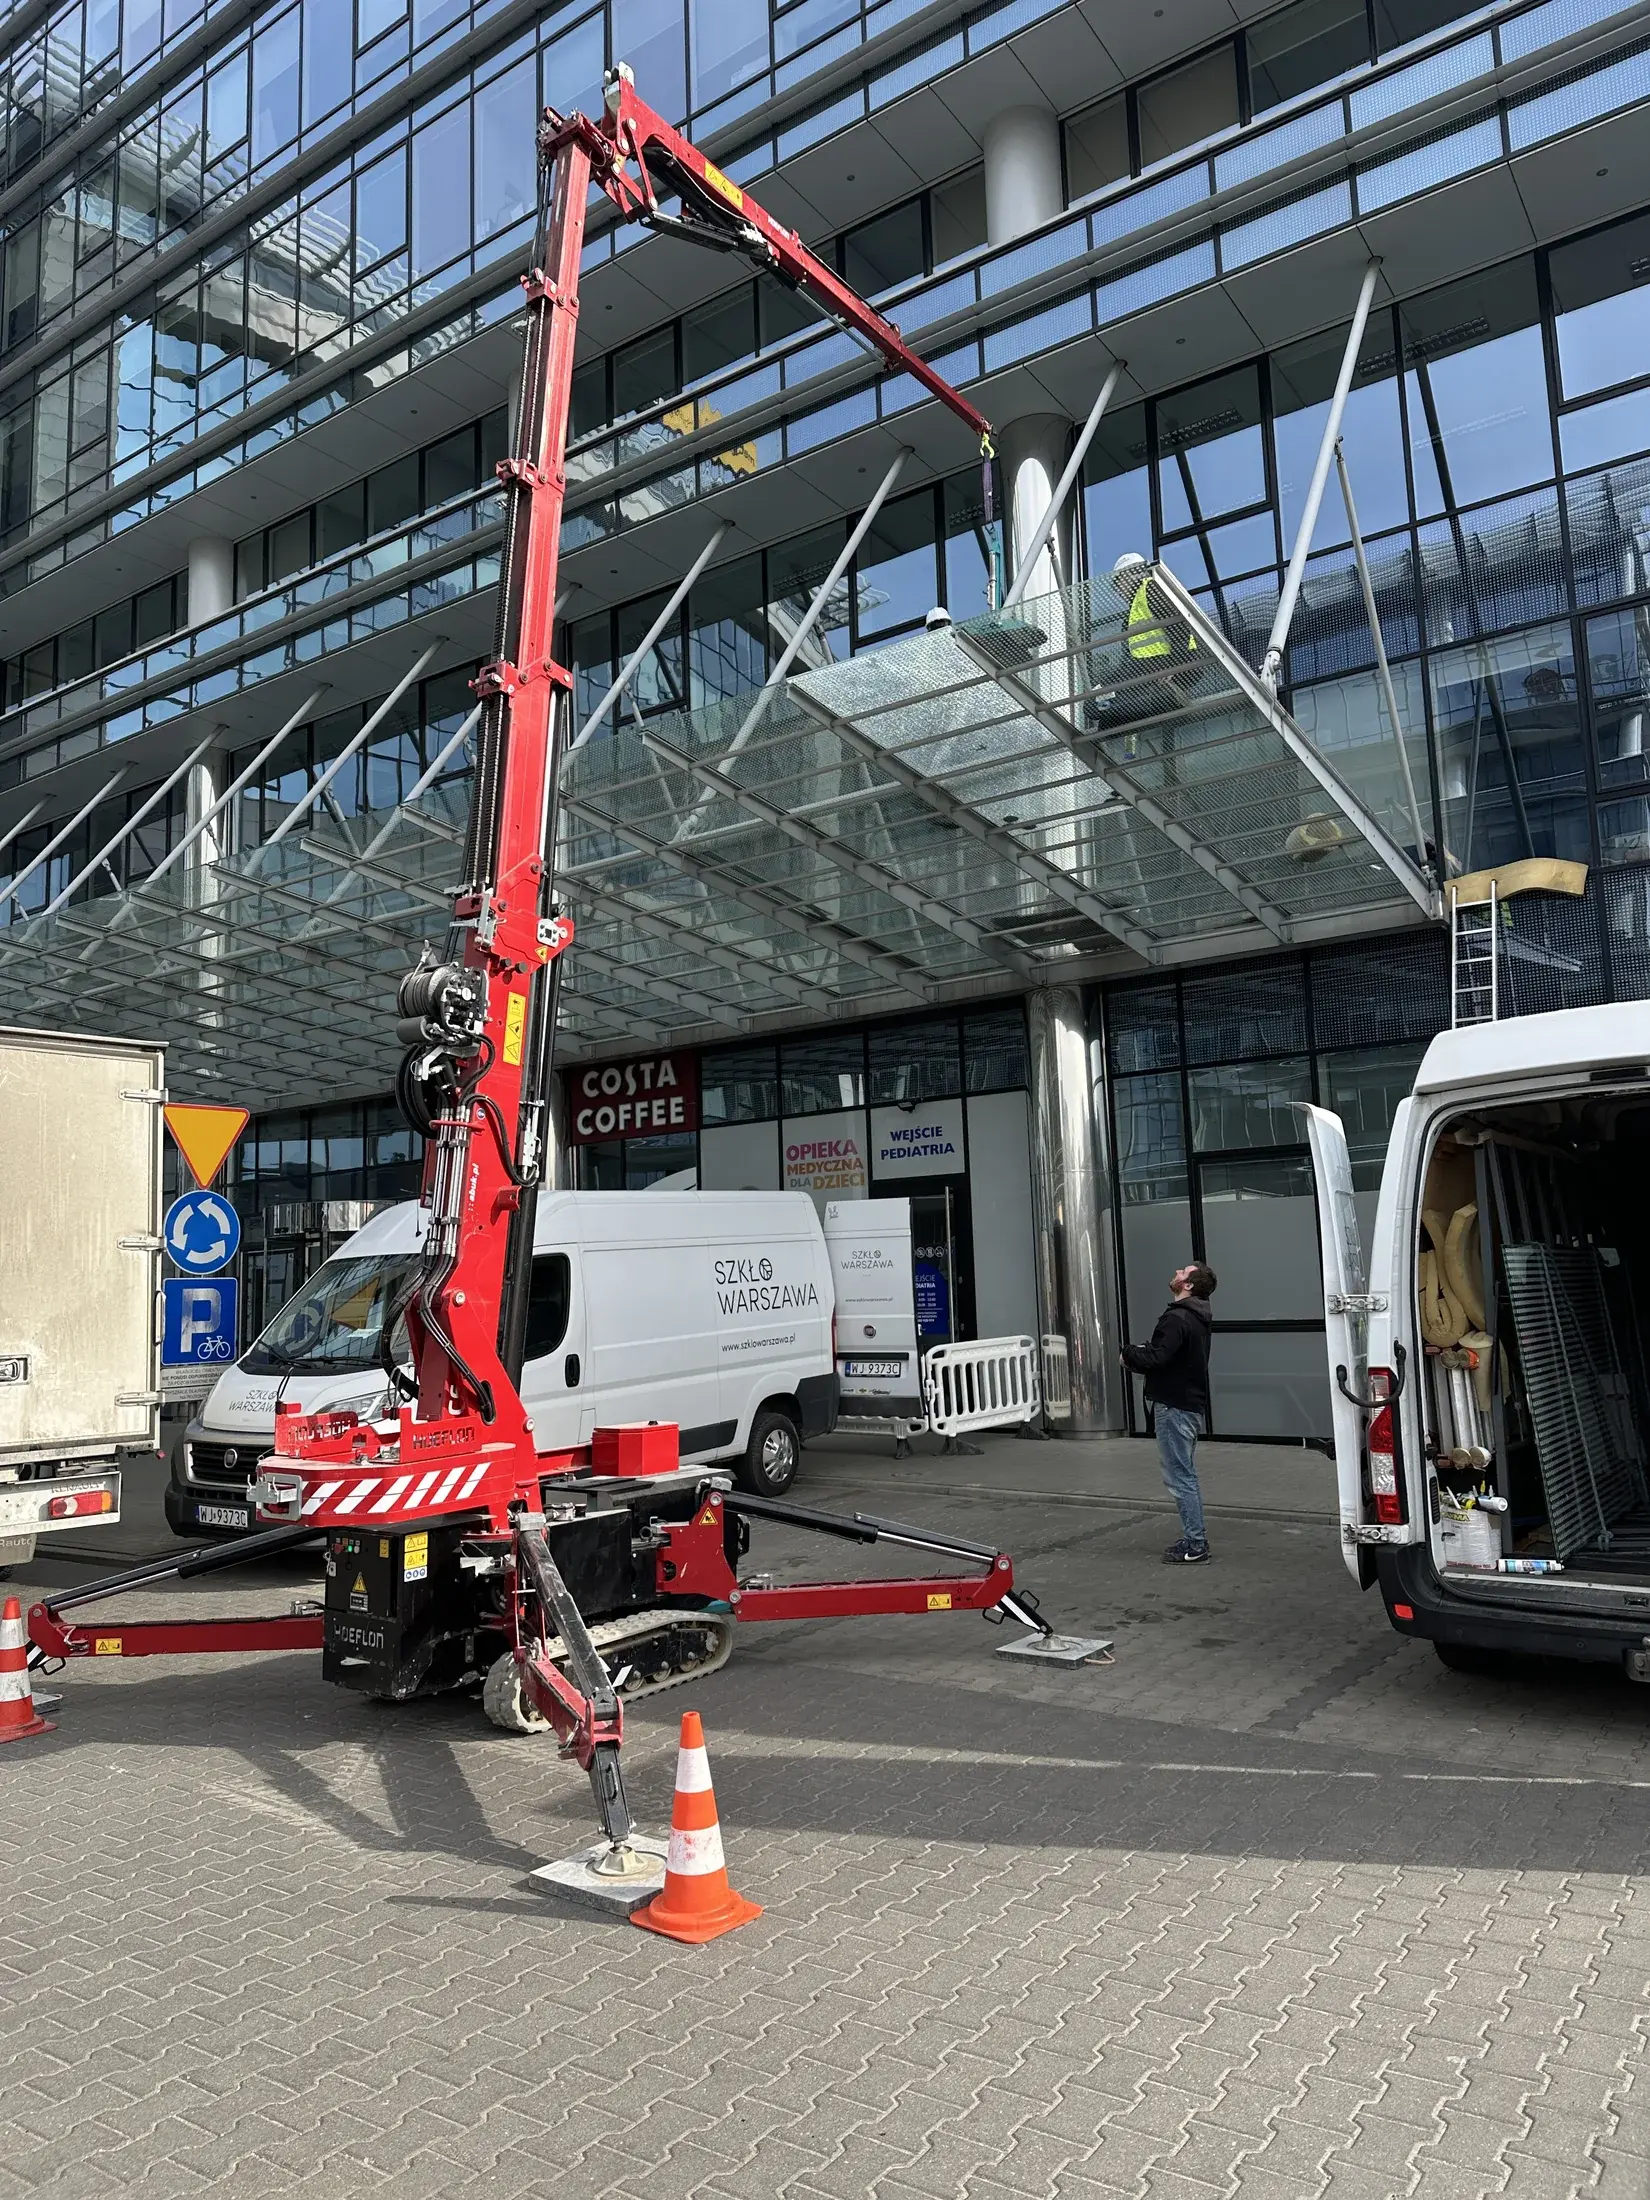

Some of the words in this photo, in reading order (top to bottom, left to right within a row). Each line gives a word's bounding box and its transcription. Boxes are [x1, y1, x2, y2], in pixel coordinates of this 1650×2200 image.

[582, 1060, 677, 1098] COSTA
[576, 1096, 684, 1135] COFFEE
[890, 1126, 943, 1143] WEJŚCIE
[786, 1139, 858, 1162] OPIEKA
[880, 1142, 955, 1160] PEDIATRIA
[786, 1157, 864, 1177] MEDYCZNA
[790, 1176, 811, 1188] DLA
[812, 1172, 866, 1190] DZIECI
[840, 1259, 894, 1270] WARSZAWA
[915, 1274, 936, 1282] EJŚCIE
[717, 1283, 819, 1315] WARSZAWA
[180, 1287, 222, 1353] P
[852, 1363, 865, 1374] WJ
[868, 1363, 899, 1374] 9373C
[200, 1507, 213, 1522] WJ
[217, 1509, 246, 1526] 9373C
[334, 1624, 384, 1649] HOEFLON
